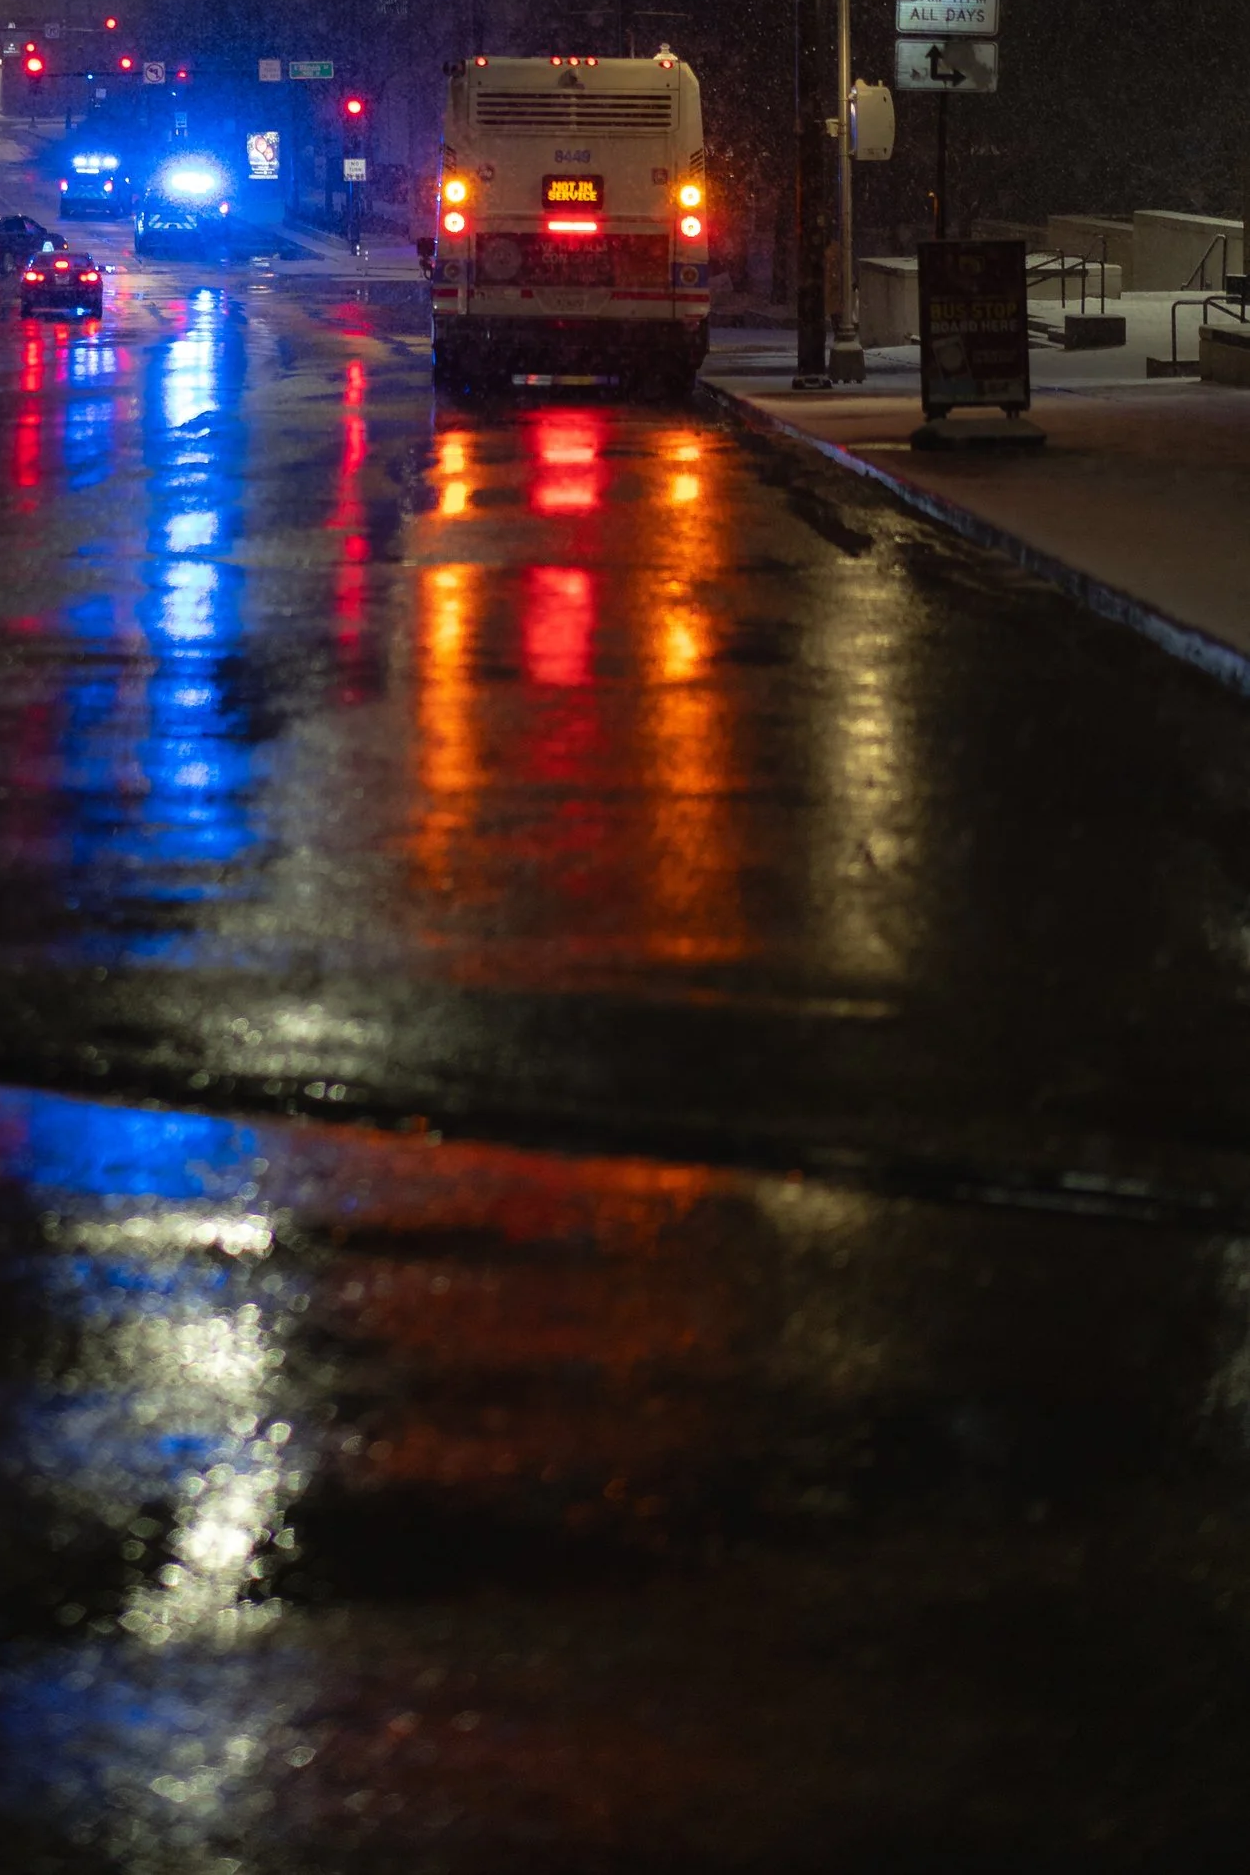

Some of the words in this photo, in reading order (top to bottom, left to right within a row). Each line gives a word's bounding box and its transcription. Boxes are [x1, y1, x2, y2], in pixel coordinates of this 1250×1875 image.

[910, 7, 939, 22] ALL
[945, 8, 986, 23] DAYS
[551, 180, 576, 192] NOT
[578, 180, 594, 192] IN
[547, 191, 598, 202] SERVICE
[930, 302, 966, 320] BUS
[970, 300, 1017, 320] STOP
[930, 320, 978, 334] BOARD
[981, 319, 1018, 333] HERE
